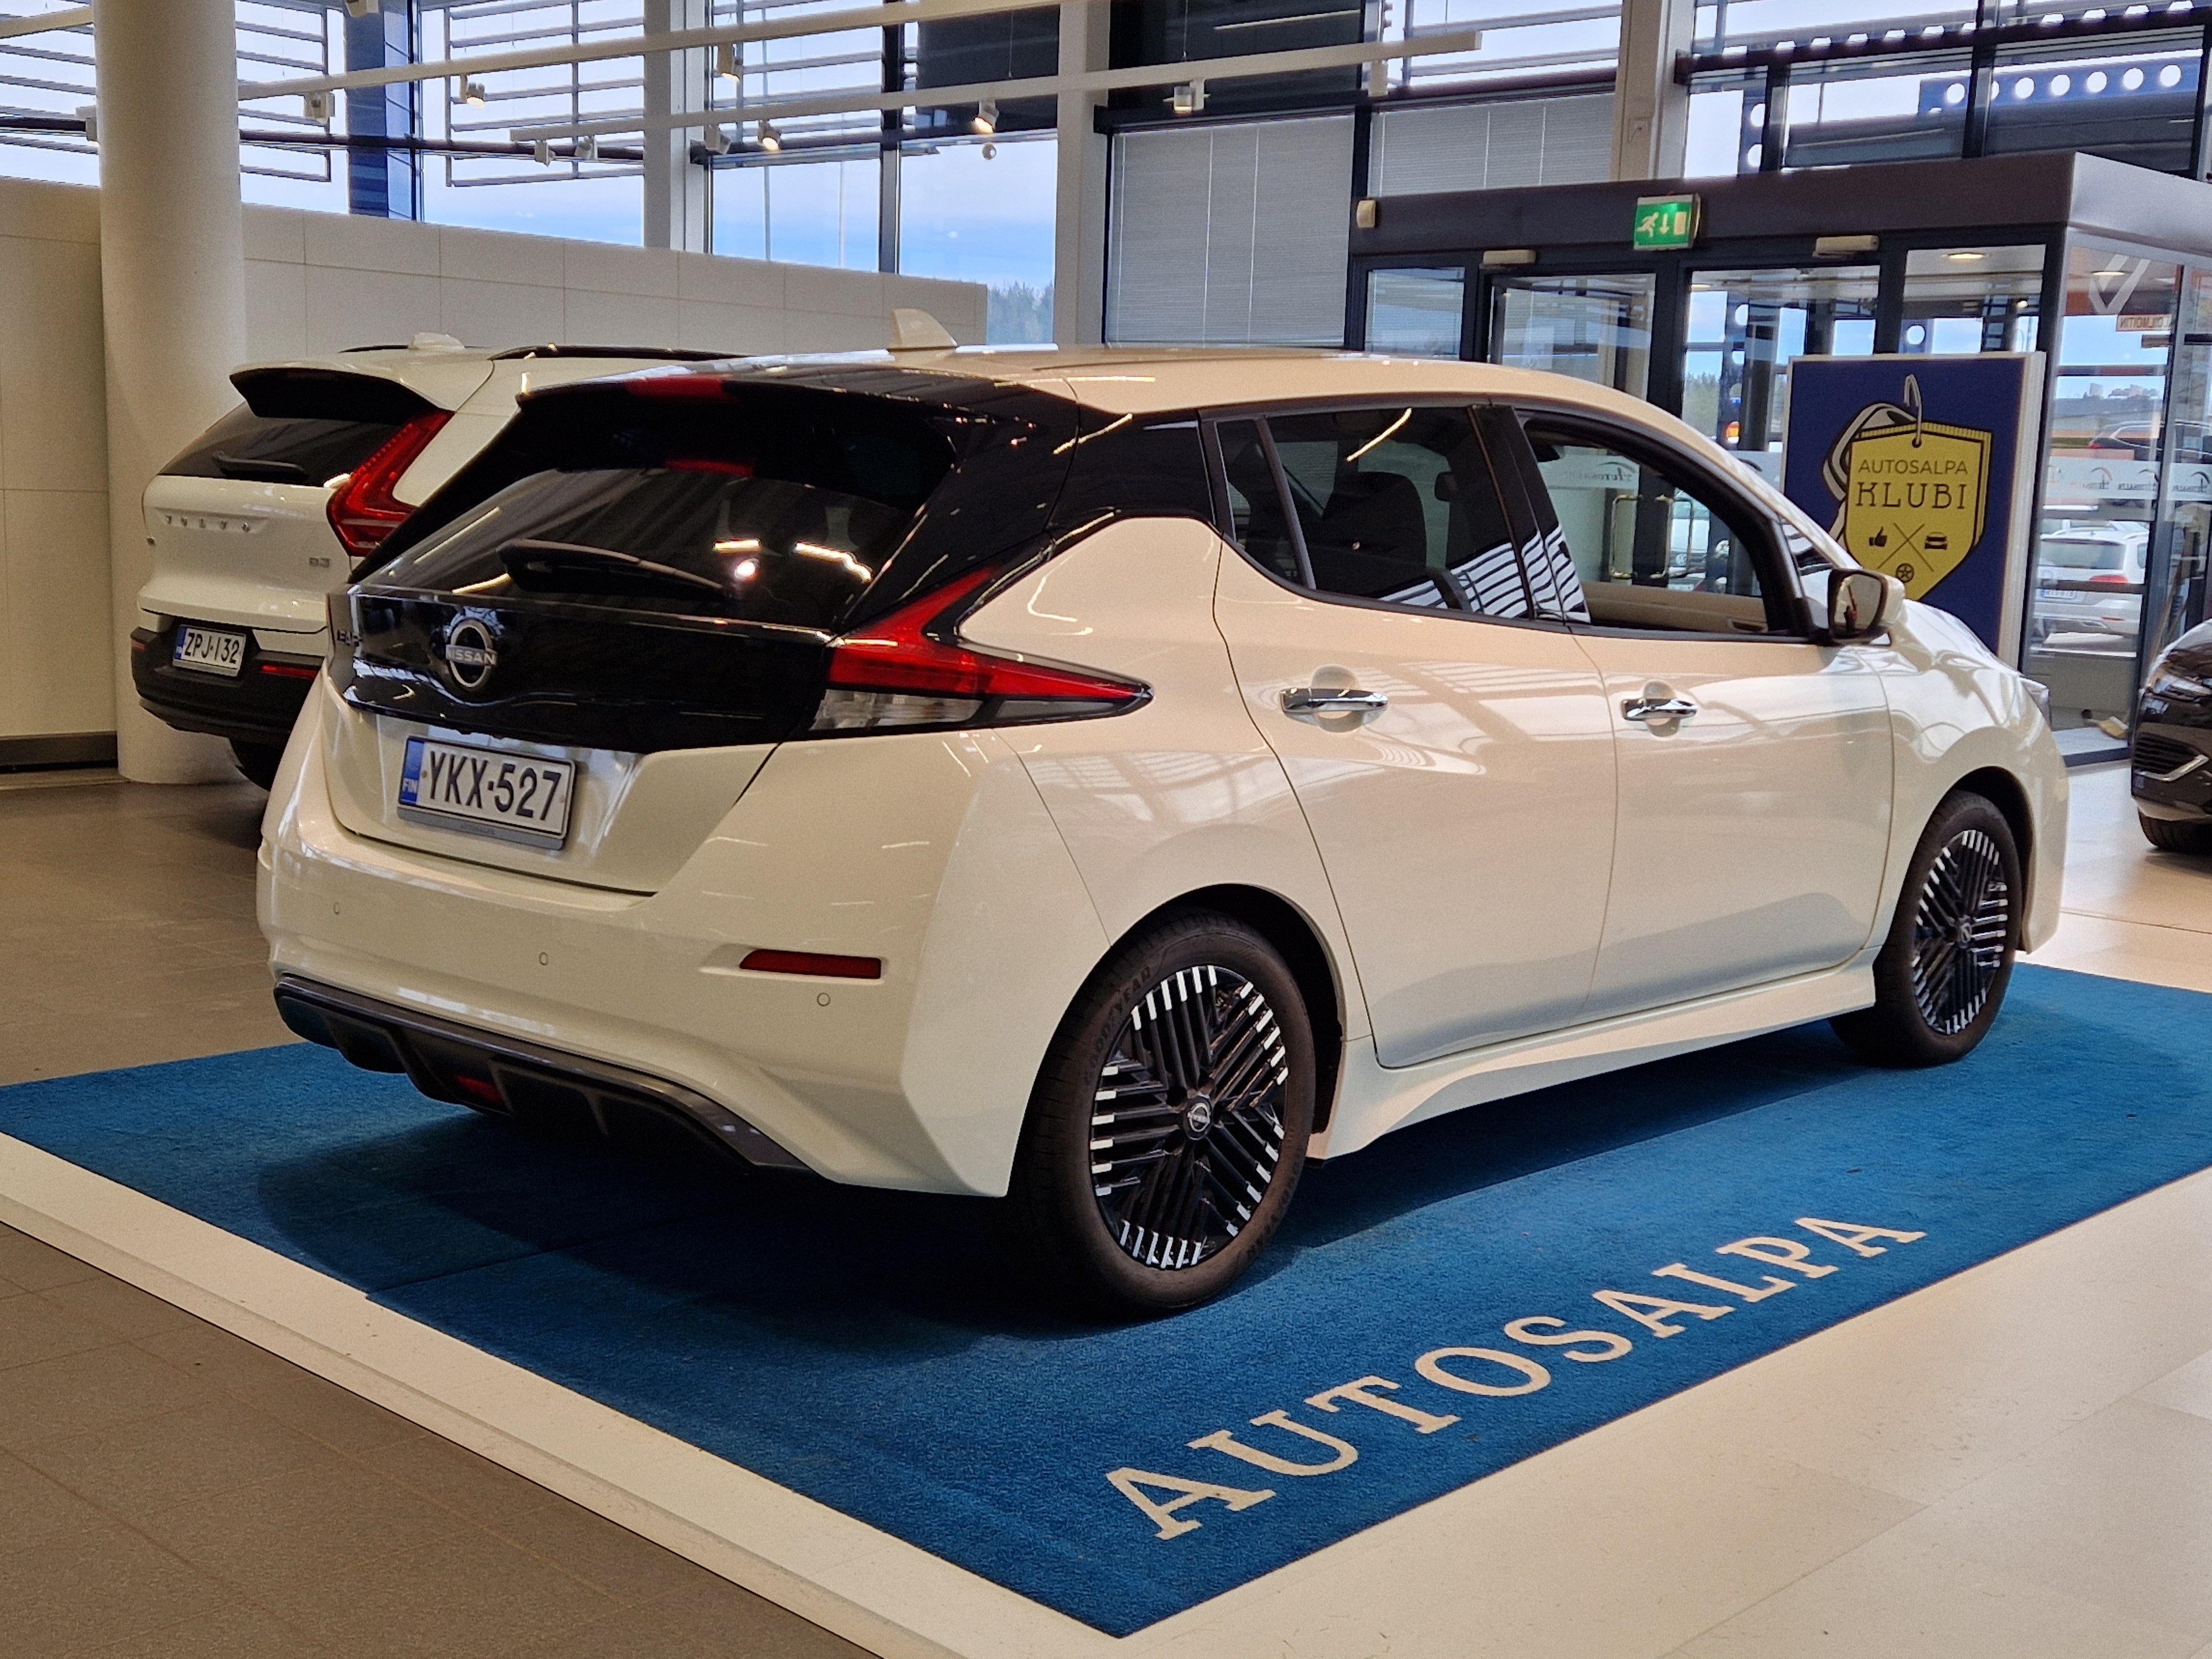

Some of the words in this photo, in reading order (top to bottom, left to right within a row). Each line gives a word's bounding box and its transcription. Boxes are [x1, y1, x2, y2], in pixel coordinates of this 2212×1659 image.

[1858, 458, 1968, 474] AUTOSALPA
[1855, 482, 1967, 509] KLUBI
[184, 632, 239, 664] ZPJ-132
[446, 647, 497, 665] NISSAN
[402, 777, 418, 790] FIN
[430, 750, 561, 821] YKX-527
[1105, 1217, 1928, 1541] AUTOSALPA
